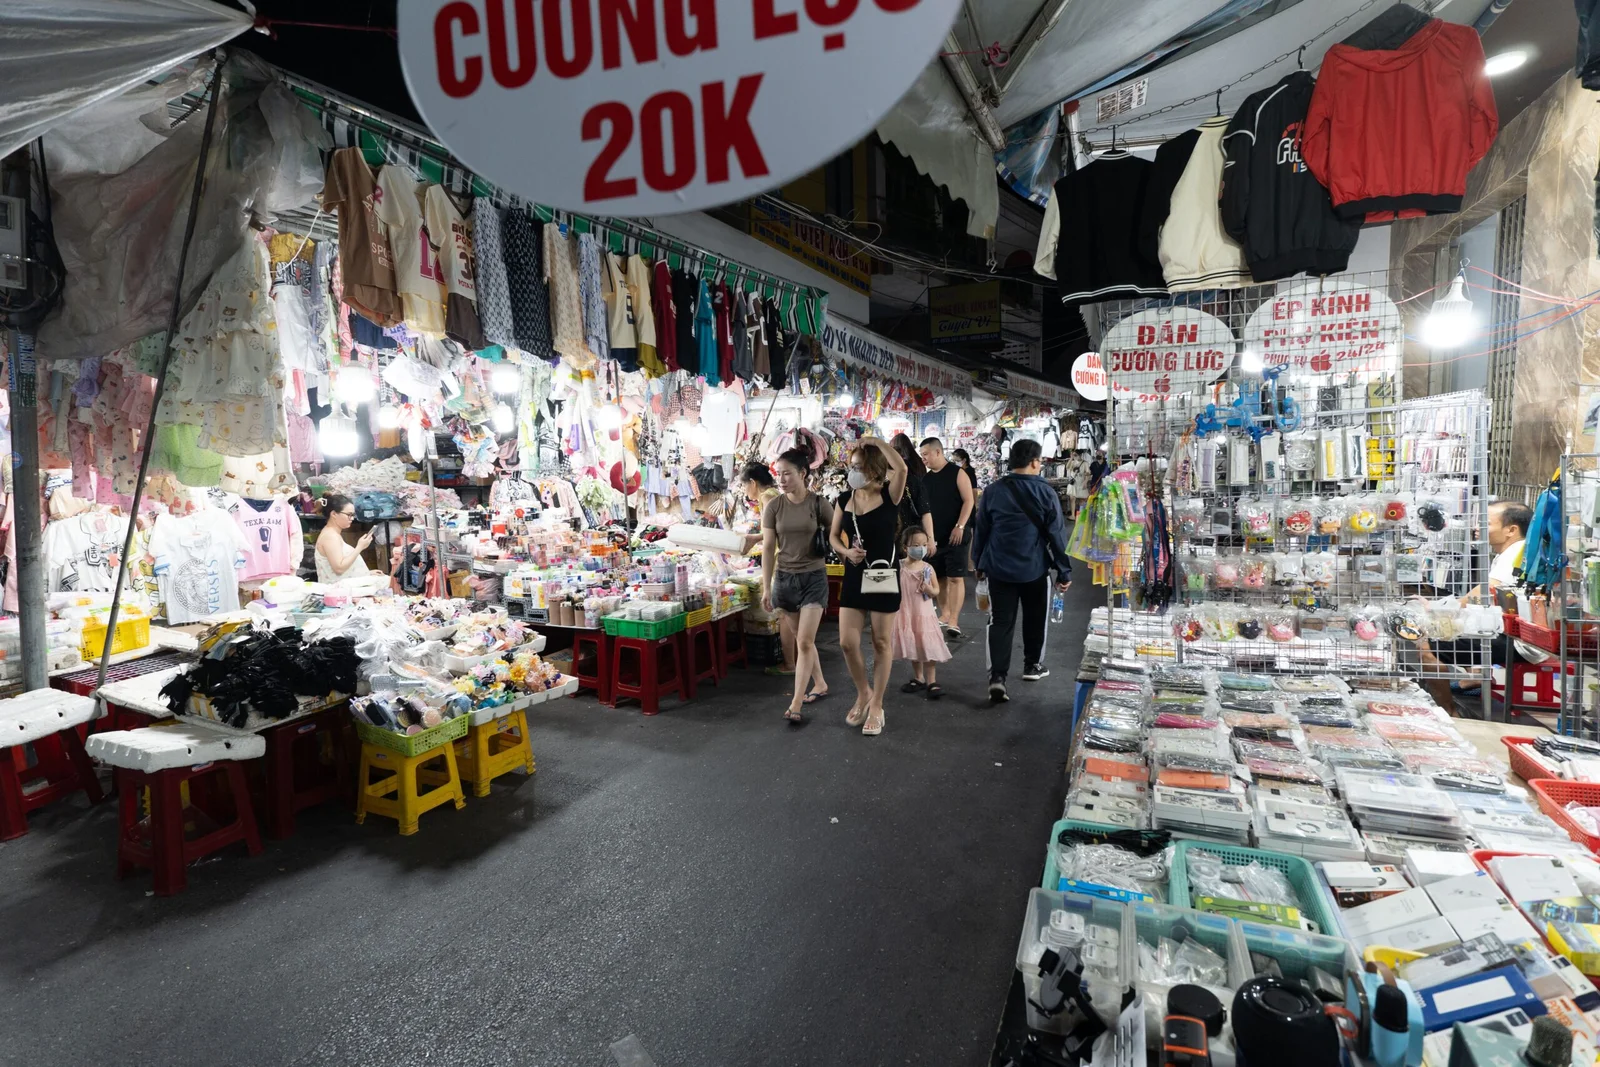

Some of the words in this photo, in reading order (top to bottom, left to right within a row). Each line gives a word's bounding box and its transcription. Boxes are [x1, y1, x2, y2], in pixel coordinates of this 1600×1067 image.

[580, 73, 770, 203] 20K
[1272, 298, 1303, 320] ÉP
[1311, 291, 1370, 317] KÍNH
[1137, 321, 1198, 346] DÁN
[1320, 318, 1379, 345] KIỆN
[848, 335, 878, 366] NHANG
